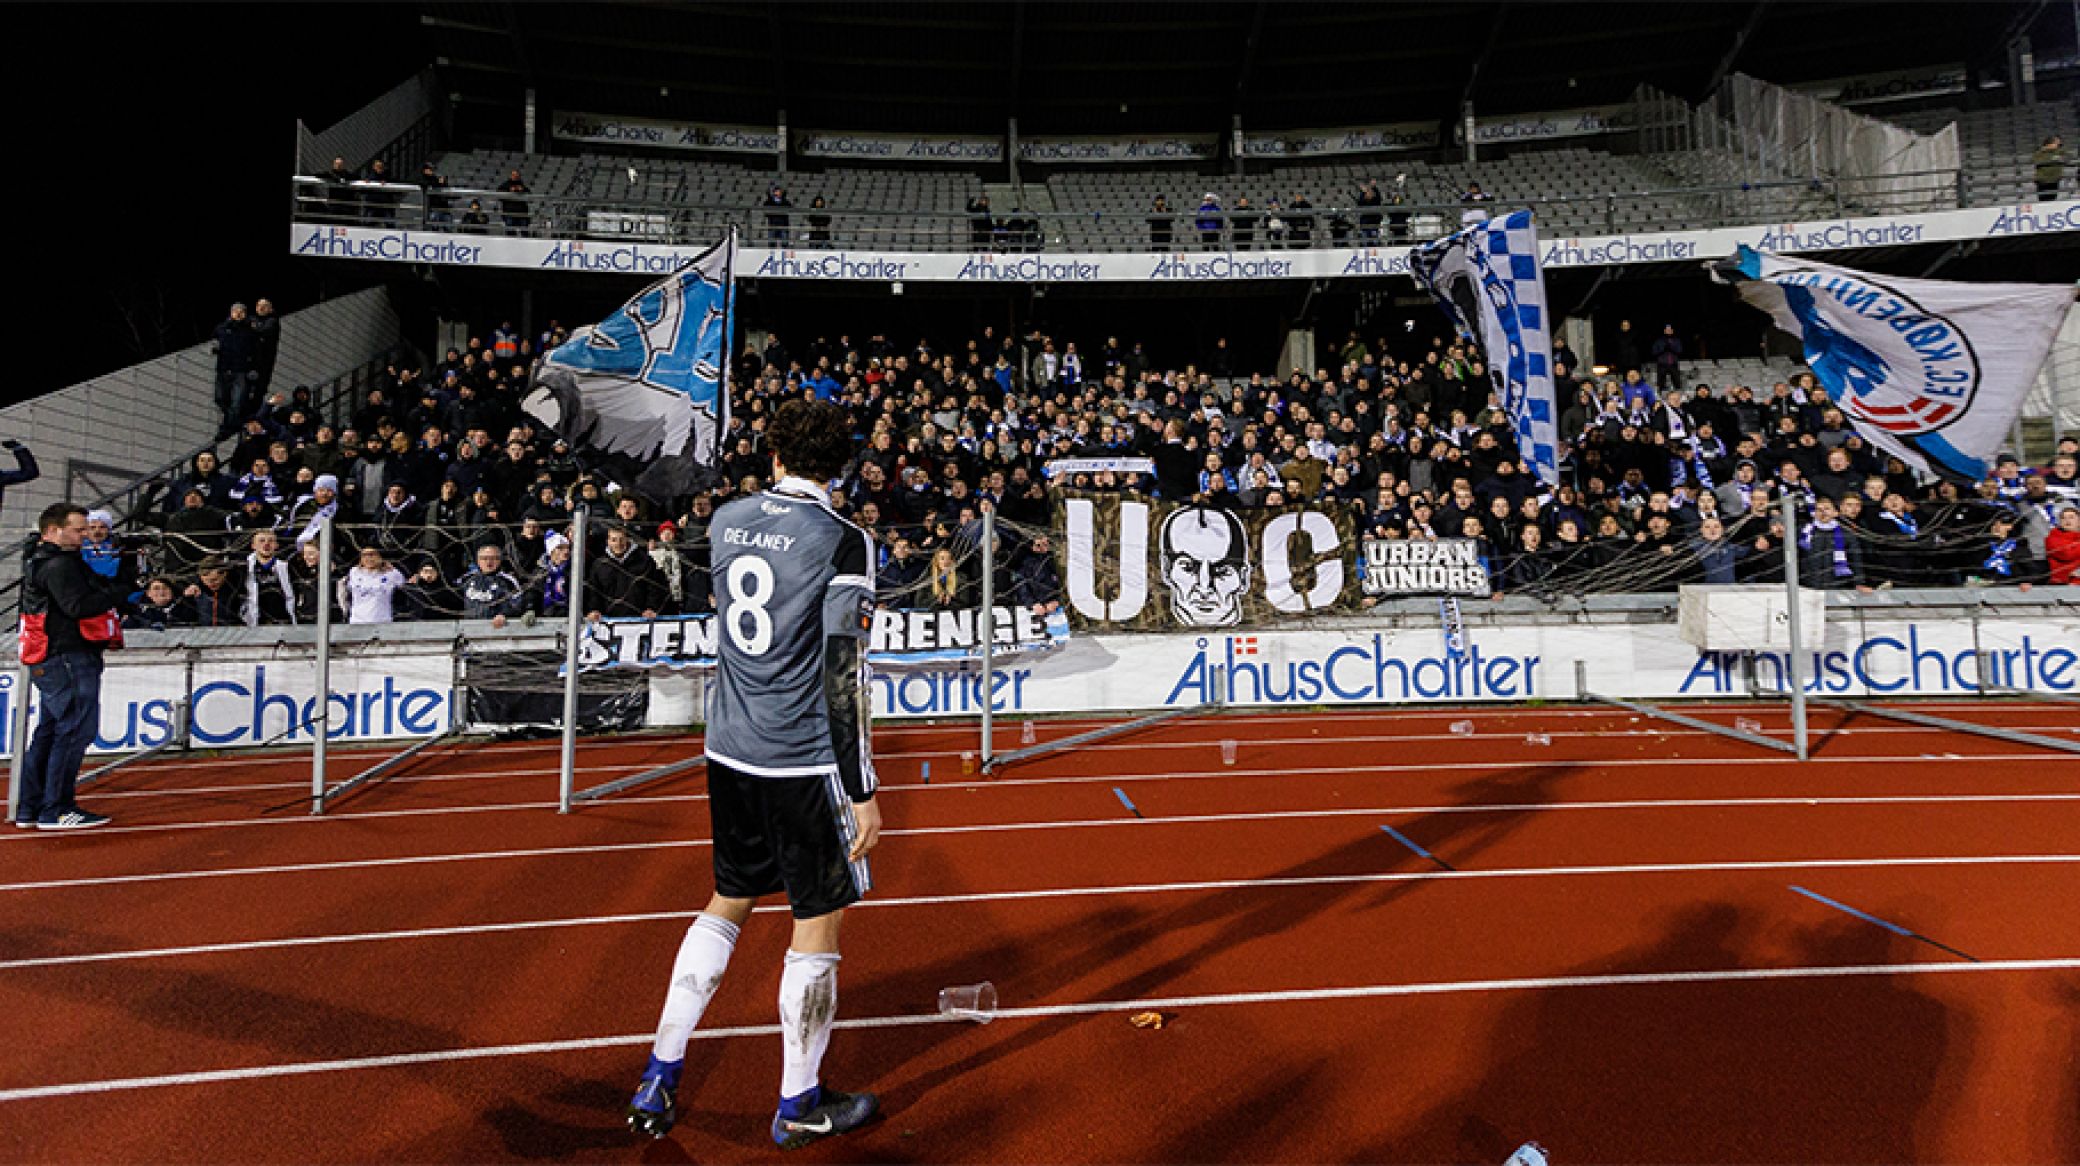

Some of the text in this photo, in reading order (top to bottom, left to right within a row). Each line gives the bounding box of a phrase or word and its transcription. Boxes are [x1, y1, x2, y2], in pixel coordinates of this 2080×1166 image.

[724, 528, 796, 551] DELANEY
[1065, 500, 1345, 622] U C
[1368, 543, 1475, 566] URBAN
[1366, 566, 1485, 589] JUNIORS
[726, 555, 774, 657] 8
[1165, 633, 1540, 704] ÅrhusCharter
